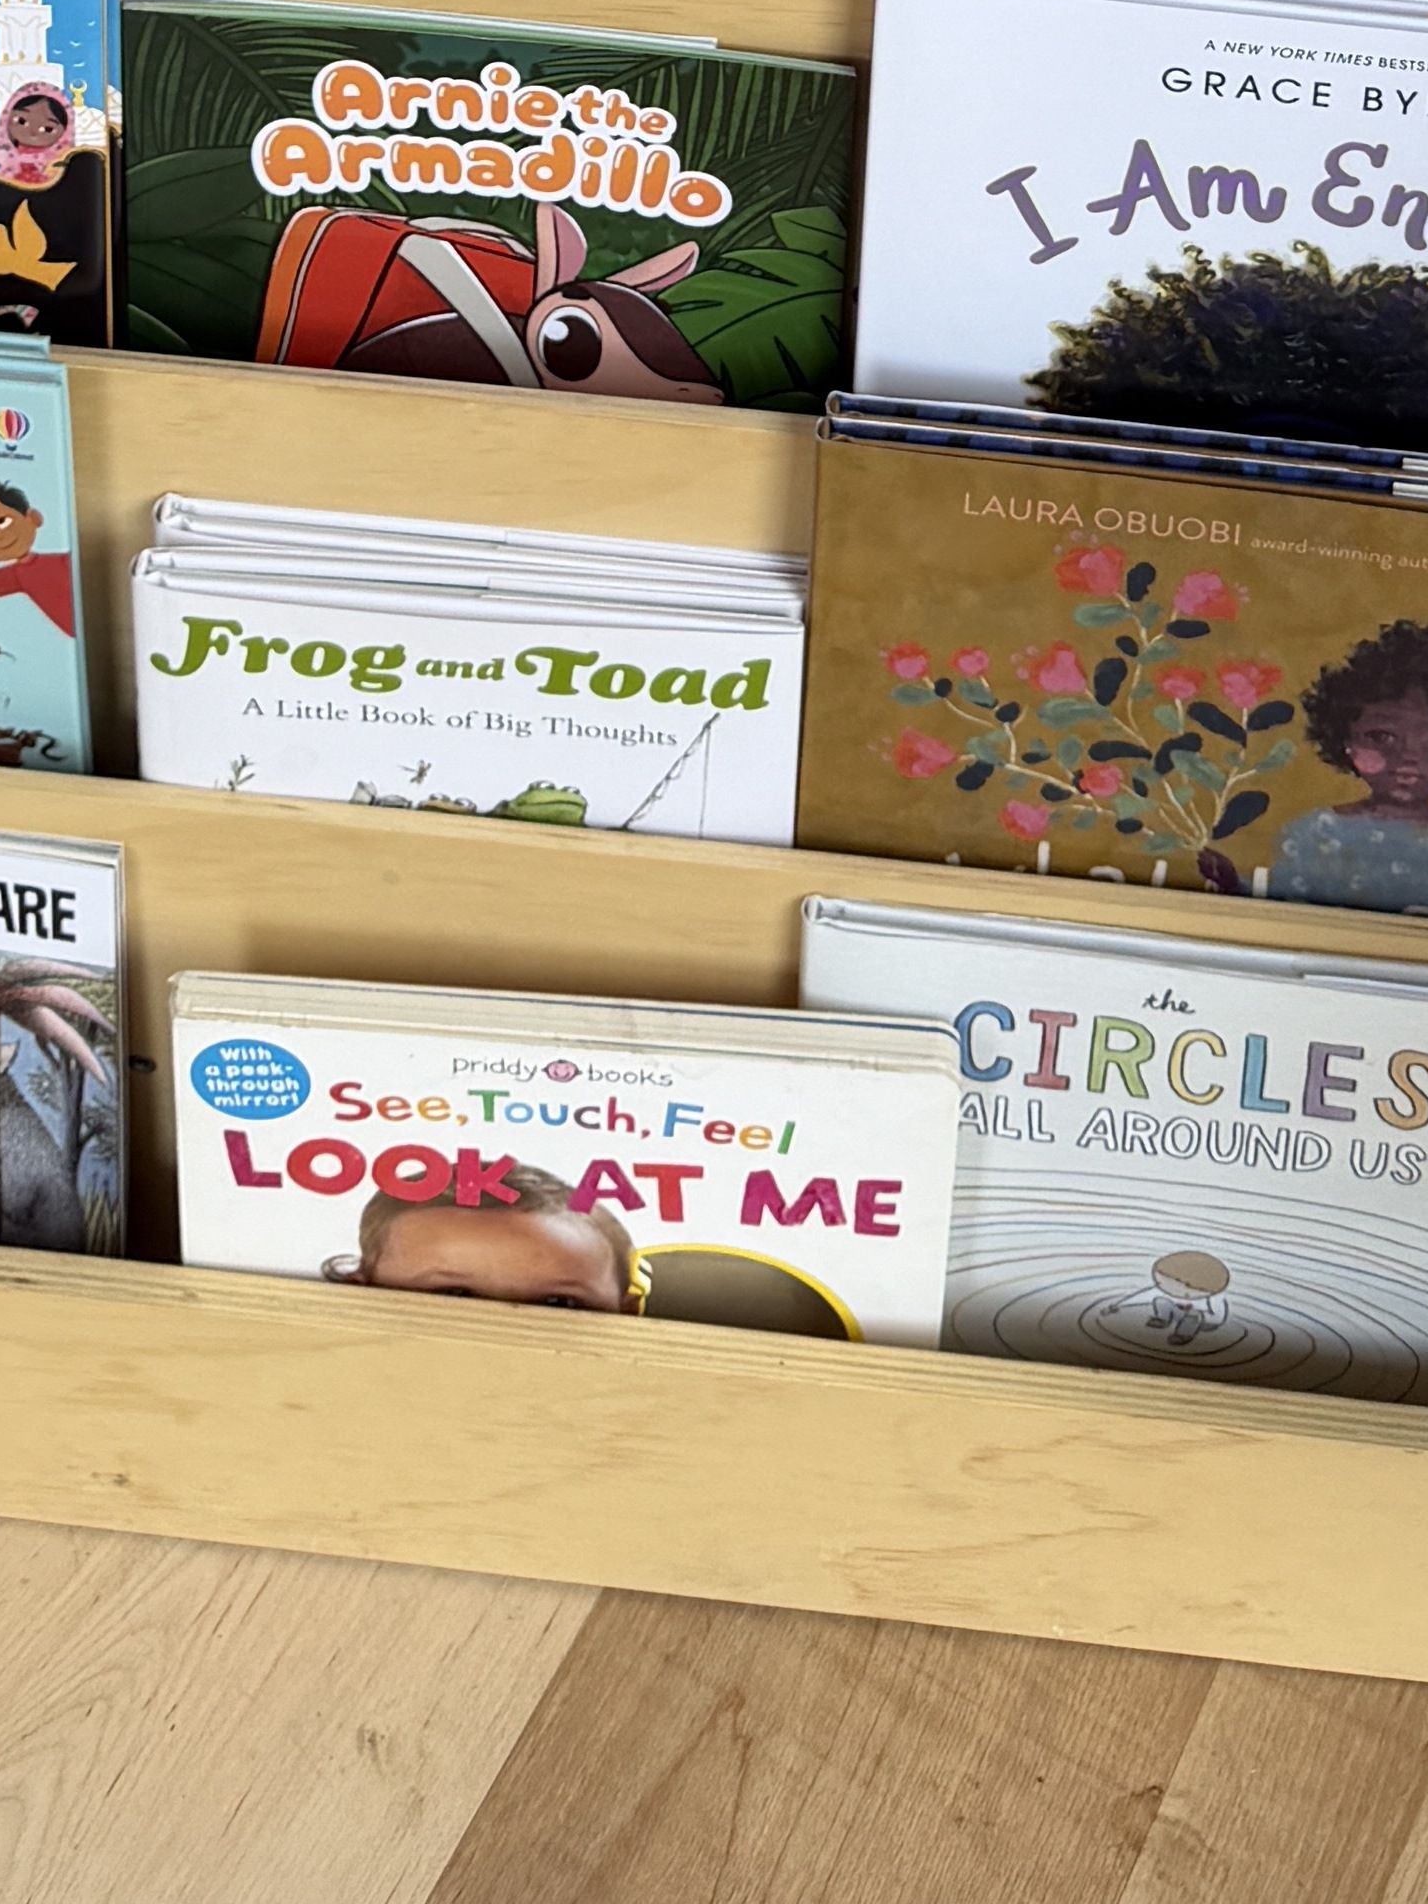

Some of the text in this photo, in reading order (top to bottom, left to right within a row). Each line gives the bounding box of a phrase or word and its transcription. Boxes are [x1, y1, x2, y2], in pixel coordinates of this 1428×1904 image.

[1223, 41, 1263, 58] NEW
[1269, 46, 1317, 63] YORK
[1323, 52, 1372, 68] TIMES
[318, 60, 676, 142] Arnie the
[1161, 66, 1334, 110] GRACE
[254, 119, 732, 226] Armadillo
[985, 165, 1079, 265] I
[1086, 137, 1286, 235] Am
[962, 489, 1085, 530] LAURA
[1093, 505, 1243, 548] OBUOBI
[1250, 533, 1392, 570] award-winning
[149, 614, 773, 712] Frog Toad
[277, 698, 678, 748] Little Book Big Thoughts
[1141, 988, 1198, 1015] the
[207, 1076, 300, 1095] through
[220, 1046, 274, 1064] With
[451, 1055, 674, 1089] priddy books
[213, 1089, 300, 1109] mirror!
[329, 1081, 798, 1156] See, Touch, Feel
[957, 1090, 1056, 1145] ALL
[1075, 1106, 1333, 1176] AROUND
[222, 1128, 904, 1239] LOOK AT ME
